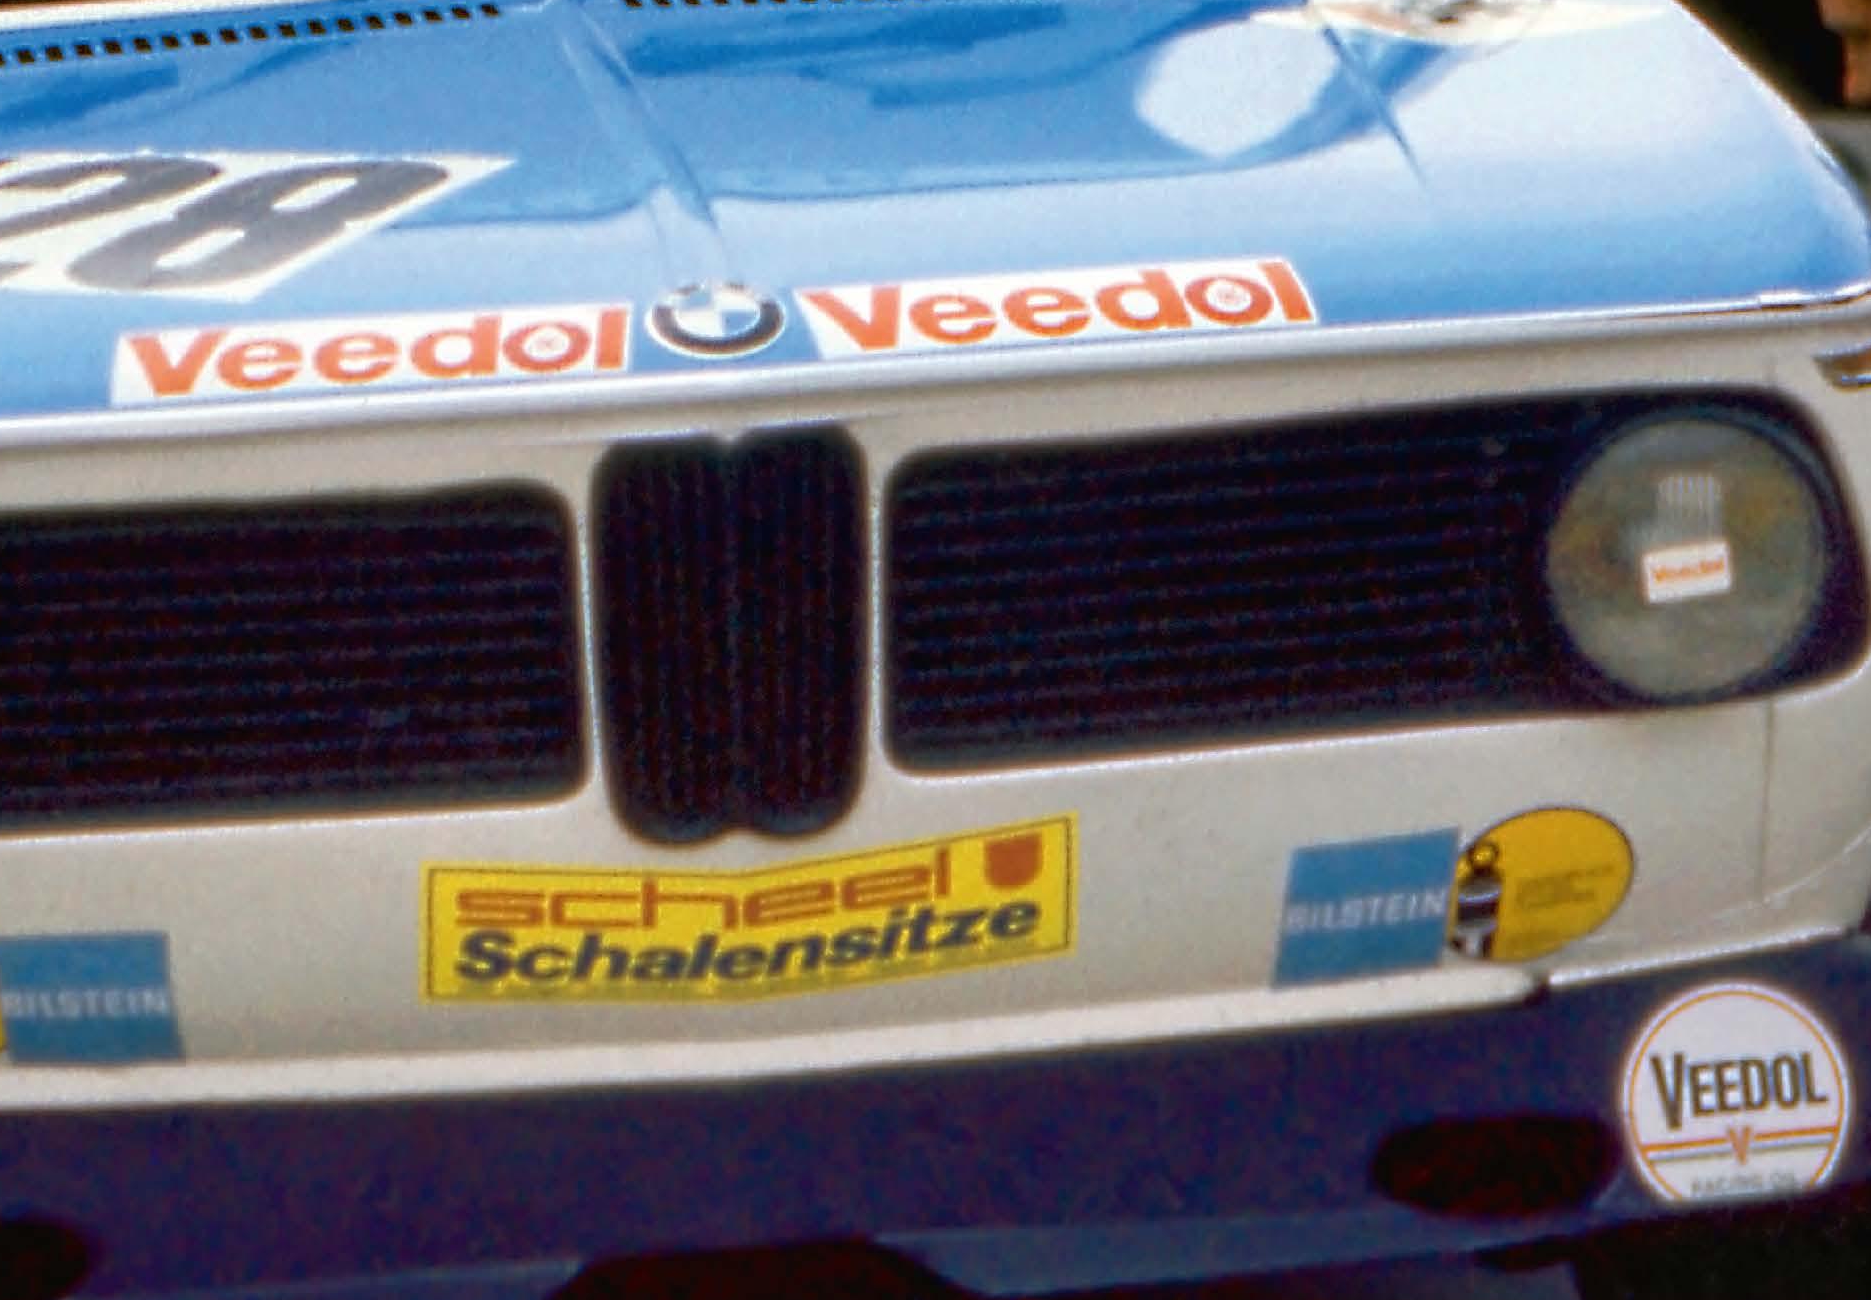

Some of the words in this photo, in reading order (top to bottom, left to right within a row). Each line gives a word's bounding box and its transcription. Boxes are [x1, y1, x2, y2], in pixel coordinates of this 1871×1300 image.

[130, 305, 628, 397] Veedol
[795, 261, 1318, 354] Veedol
[455, 845, 952, 929] scheel
[455, 900, 1040, 983] Schalensitze
